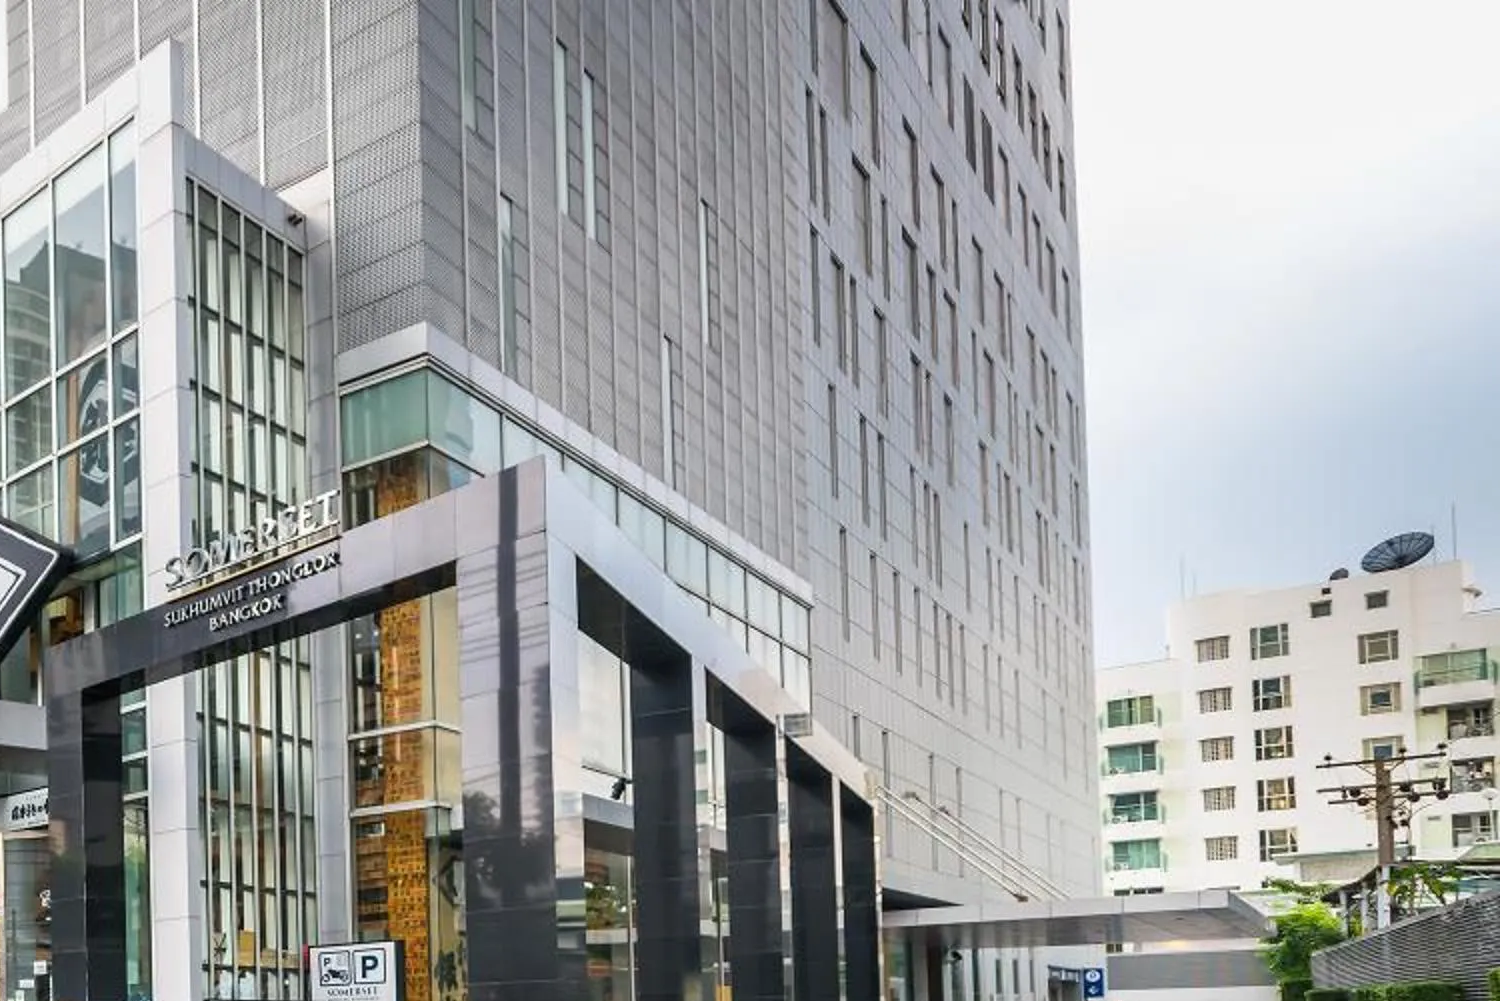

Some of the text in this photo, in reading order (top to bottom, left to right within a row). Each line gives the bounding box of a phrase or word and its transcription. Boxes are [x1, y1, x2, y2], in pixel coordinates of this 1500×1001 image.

[164, 489, 342, 588] SOMERSET
[163, 584, 244, 628] SUKHUMVIT
[208, 593, 285, 632] BANGKOK
[362, 955, 379, 979] P
